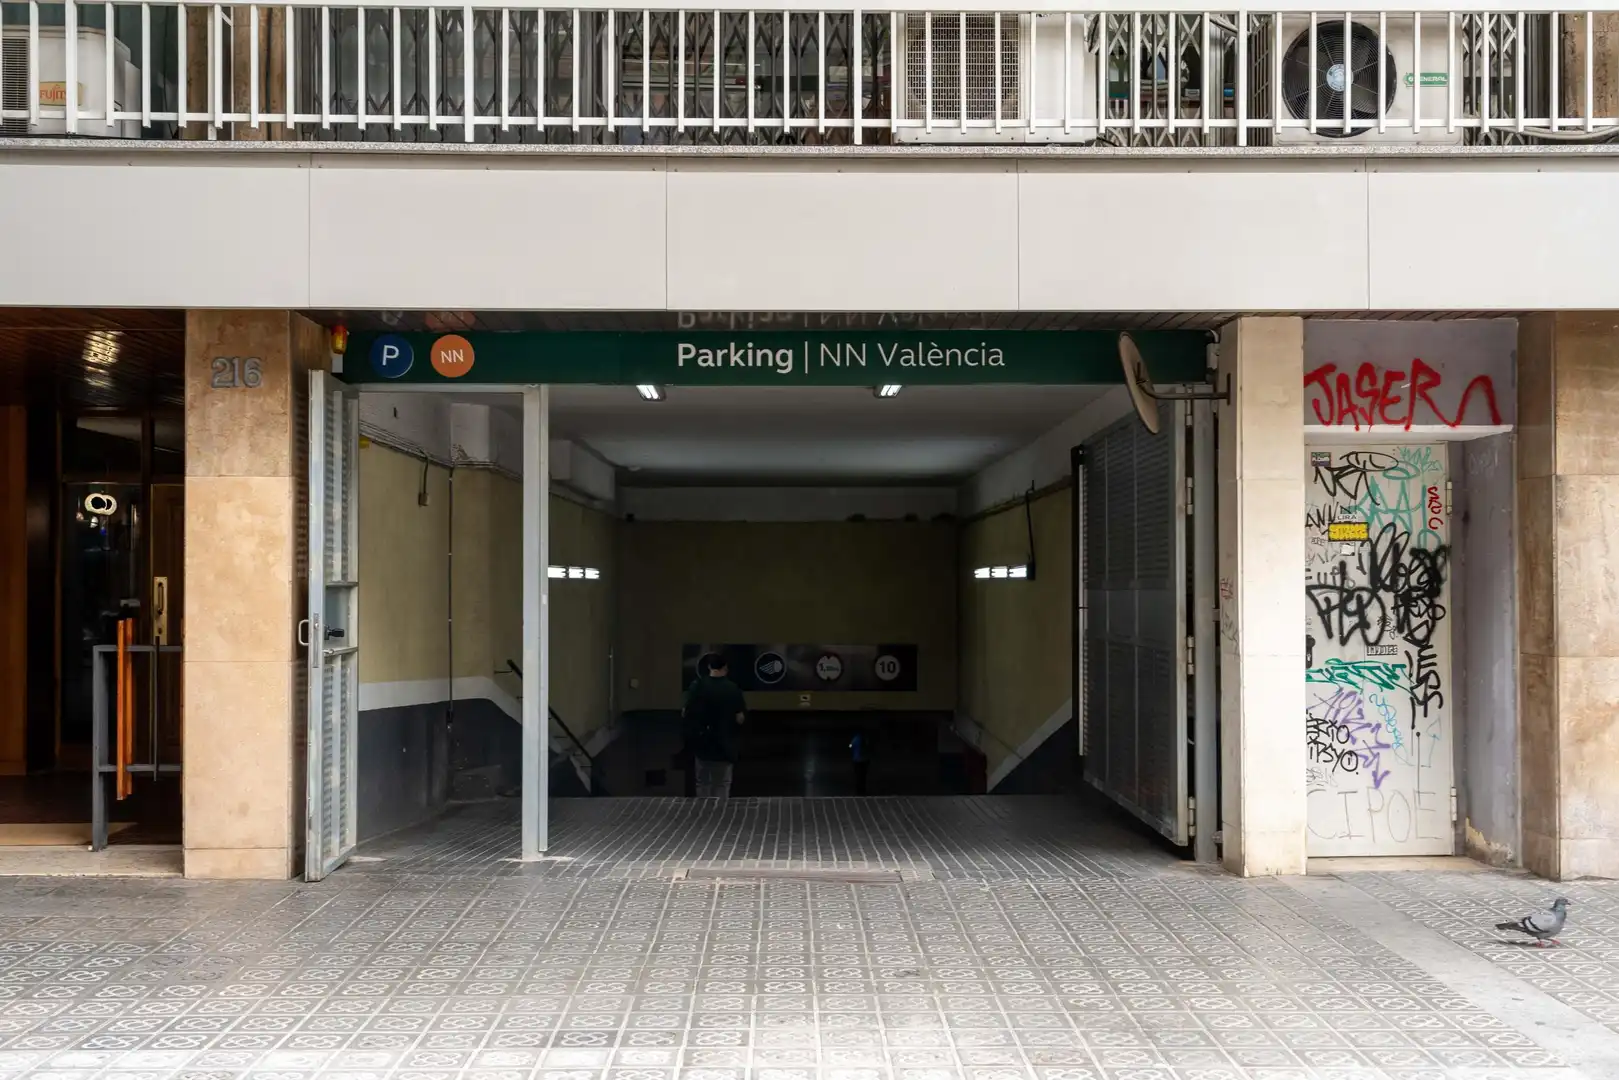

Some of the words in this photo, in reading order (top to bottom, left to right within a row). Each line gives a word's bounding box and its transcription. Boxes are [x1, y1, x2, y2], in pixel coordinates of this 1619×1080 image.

[382, 345, 399, 366] P
[440, 349, 464, 364] NN
[677, 342, 793, 374] Parking
[820, 343, 866, 367] NN
[877, 342, 1005, 367] València
[211, 357, 264, 389] 216
[879, 661, 896, 674] 10
